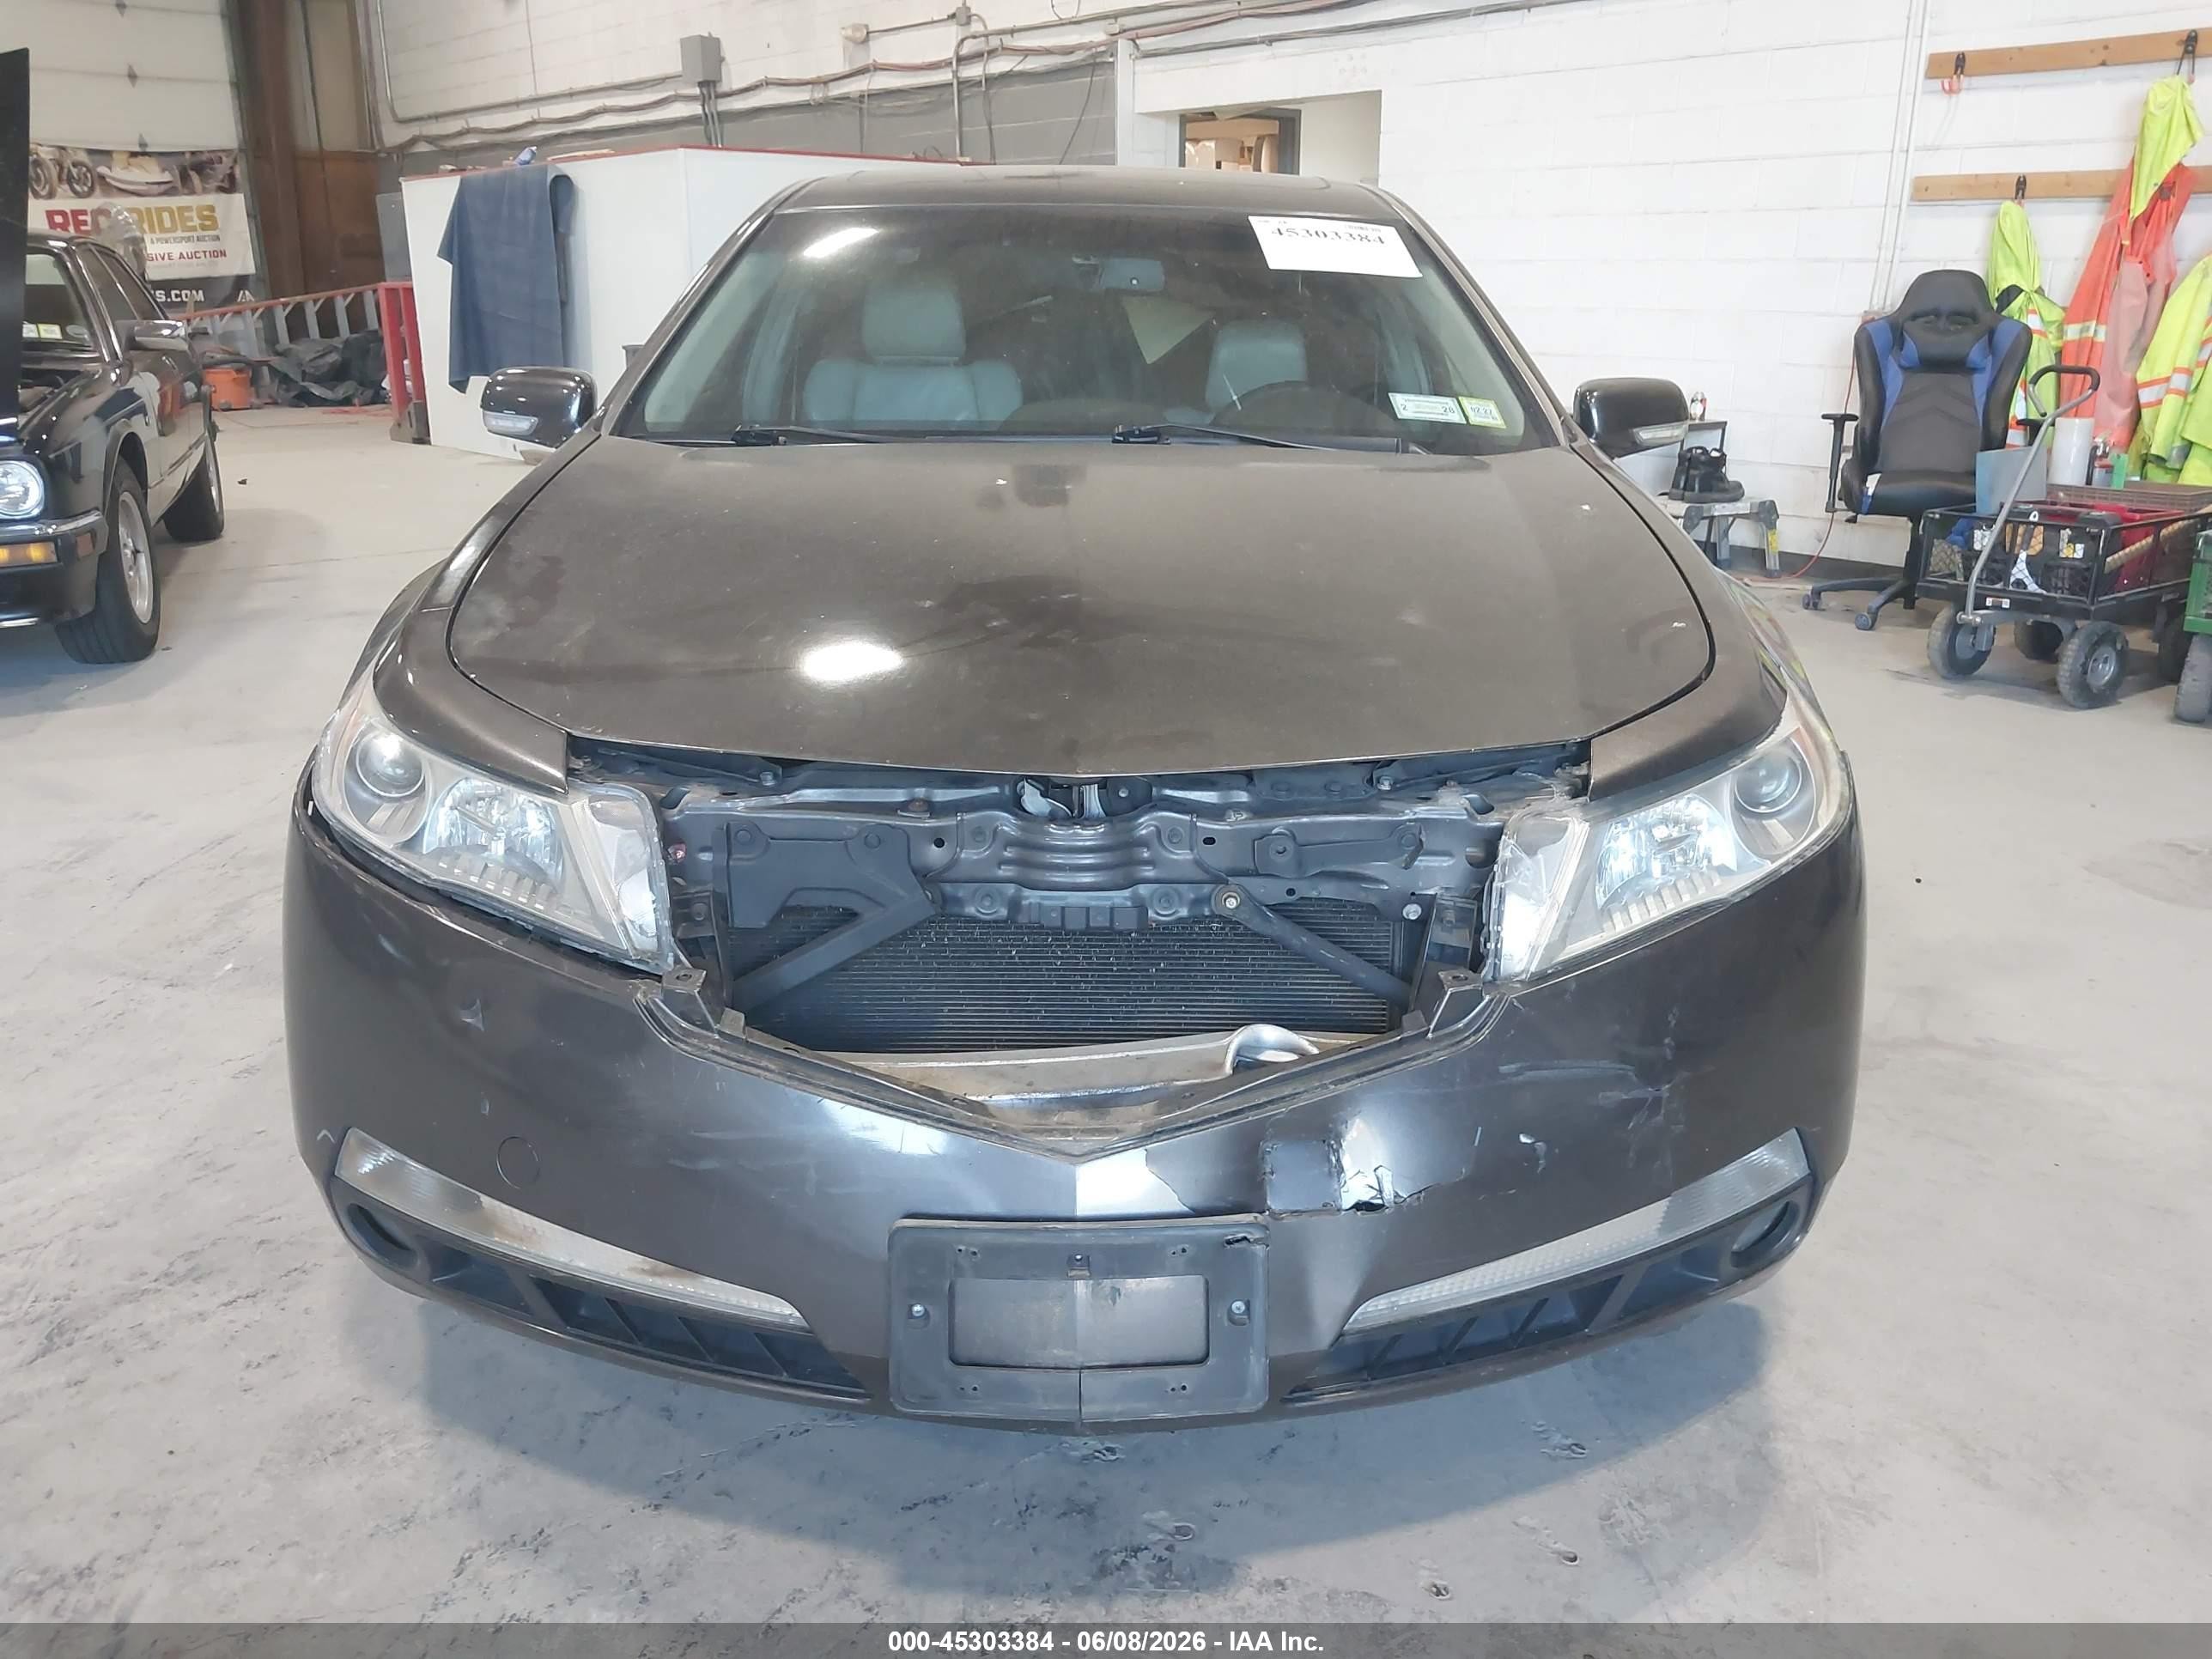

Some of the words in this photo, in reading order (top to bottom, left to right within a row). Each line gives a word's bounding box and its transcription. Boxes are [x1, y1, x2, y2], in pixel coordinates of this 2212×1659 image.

[196, 234, 221, 242] AUCTION
[1271, 227, 1385, 245] 45303384
[178, 249, 228, 260] AUCTION
[152, 289, 204, 302] S.COM
